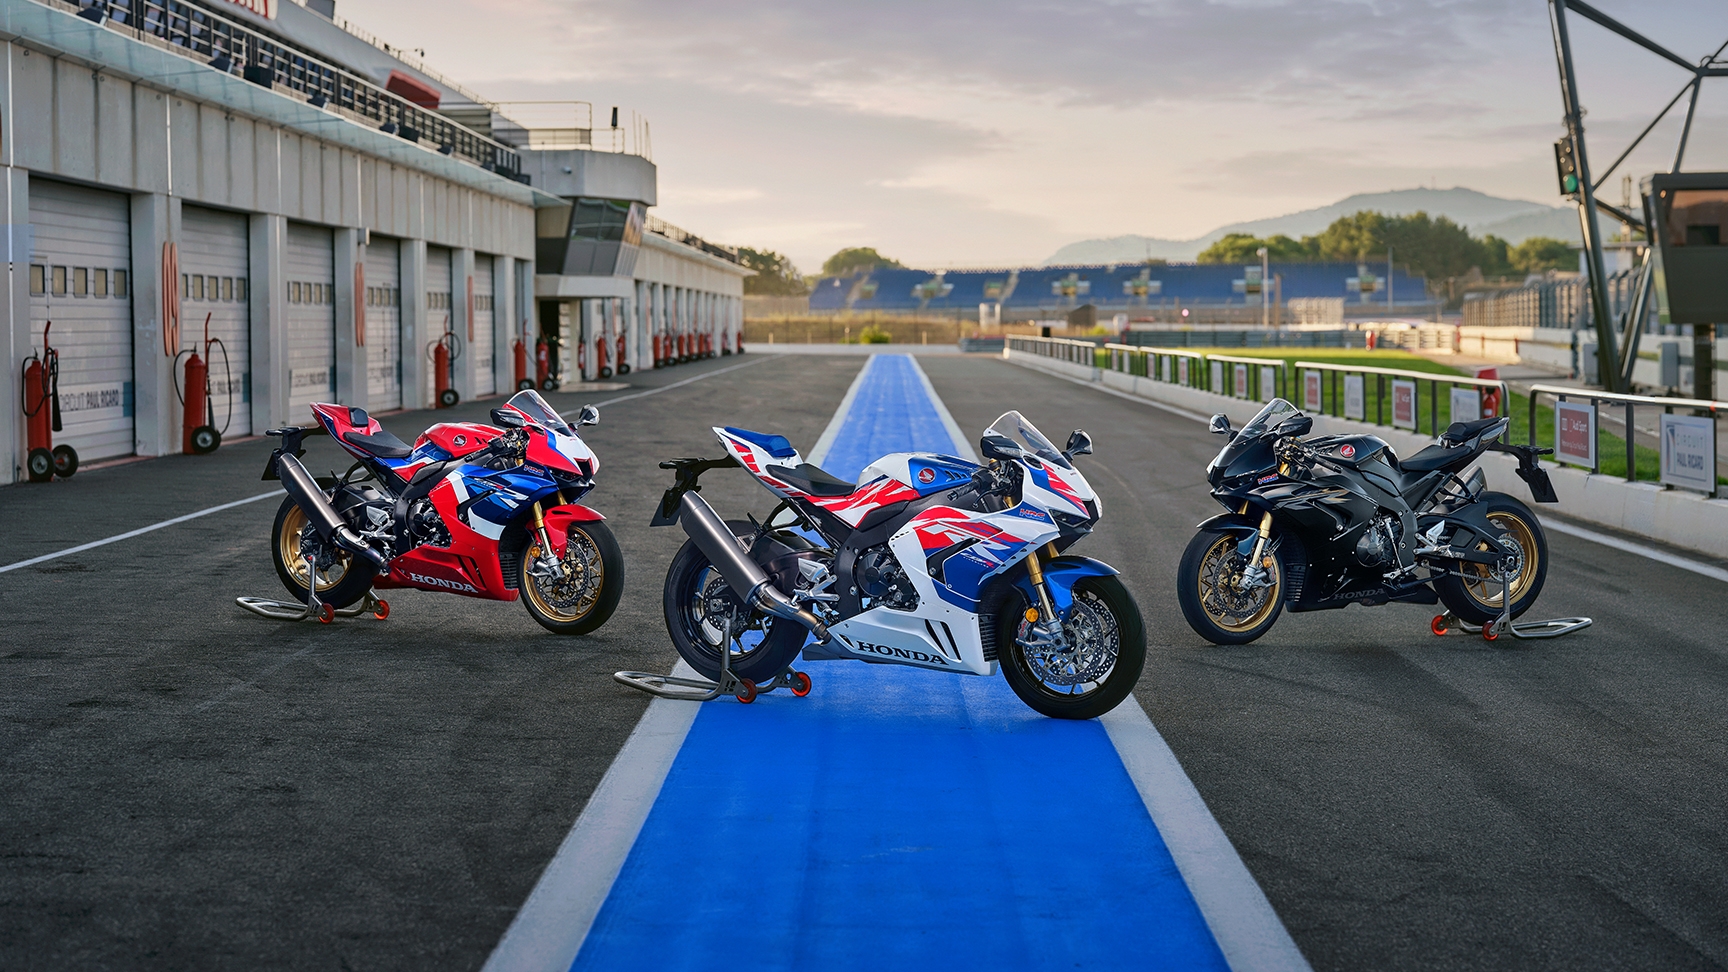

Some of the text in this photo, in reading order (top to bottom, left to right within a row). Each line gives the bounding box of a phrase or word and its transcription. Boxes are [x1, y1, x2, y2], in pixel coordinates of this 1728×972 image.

[86, 391, 100, 409] PAUL
[101, 389, 119, 407] RICARD
[1677, 452, 1704, 471] PAUL RICARD
[409, 572, 479, 594] HONDA
[1333, 588, 1386, 600] HONDA
[856, 640, 950, 666] HONDA
